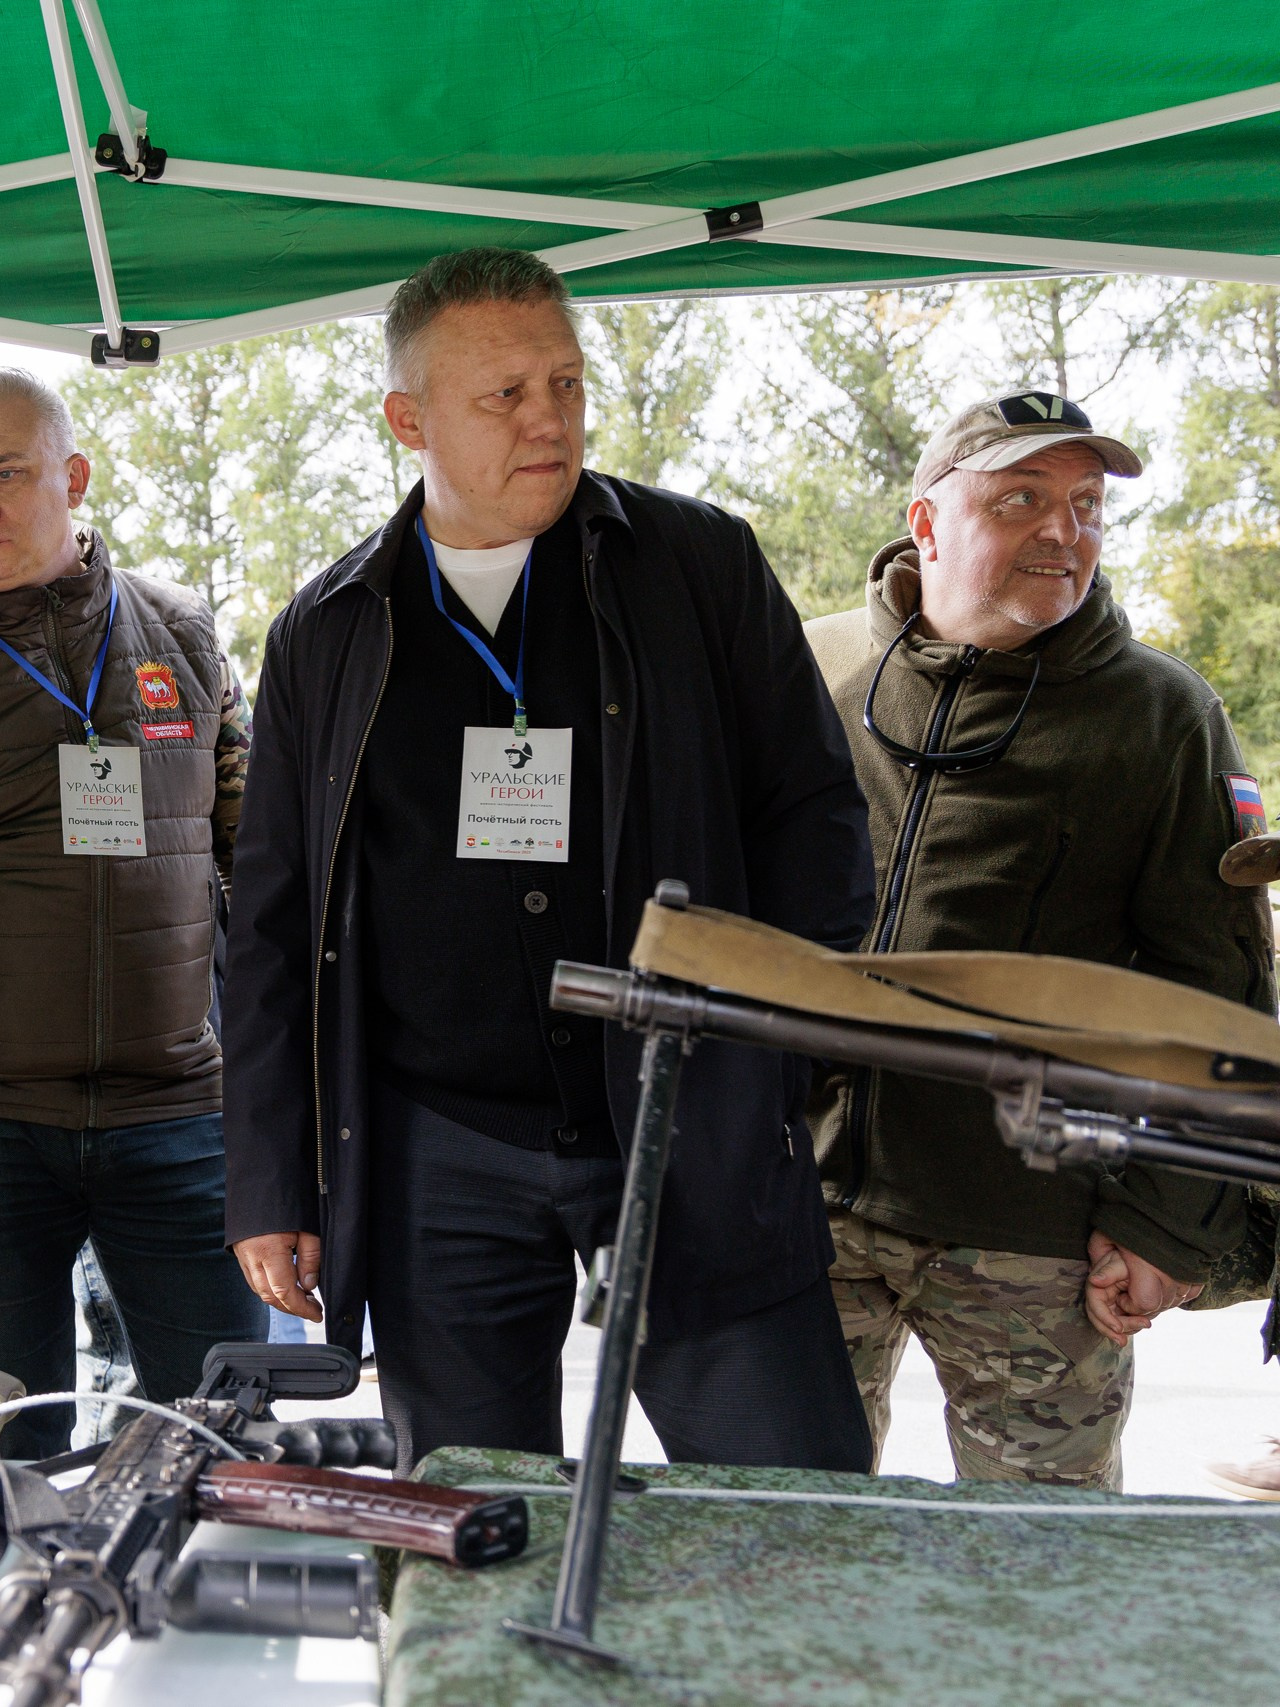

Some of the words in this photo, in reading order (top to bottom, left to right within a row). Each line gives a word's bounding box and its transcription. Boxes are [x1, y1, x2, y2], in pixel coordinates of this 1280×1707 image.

[155, 729, 183, 737] ОБЛАСТЬ
[470, 771, 566, 786] УРАЛЬСКИЕ
[66, 781, 139, 794] УРАЛЬСКИЕ
[490, 786, 544, 800] ГЕРОИ
[83, 795, 124, 806] ГЕРОИ
[68, 817, 113, 826] Почётный
[467, 814, 526, 825] Почётный
[530, 818, 562, 826] гость
